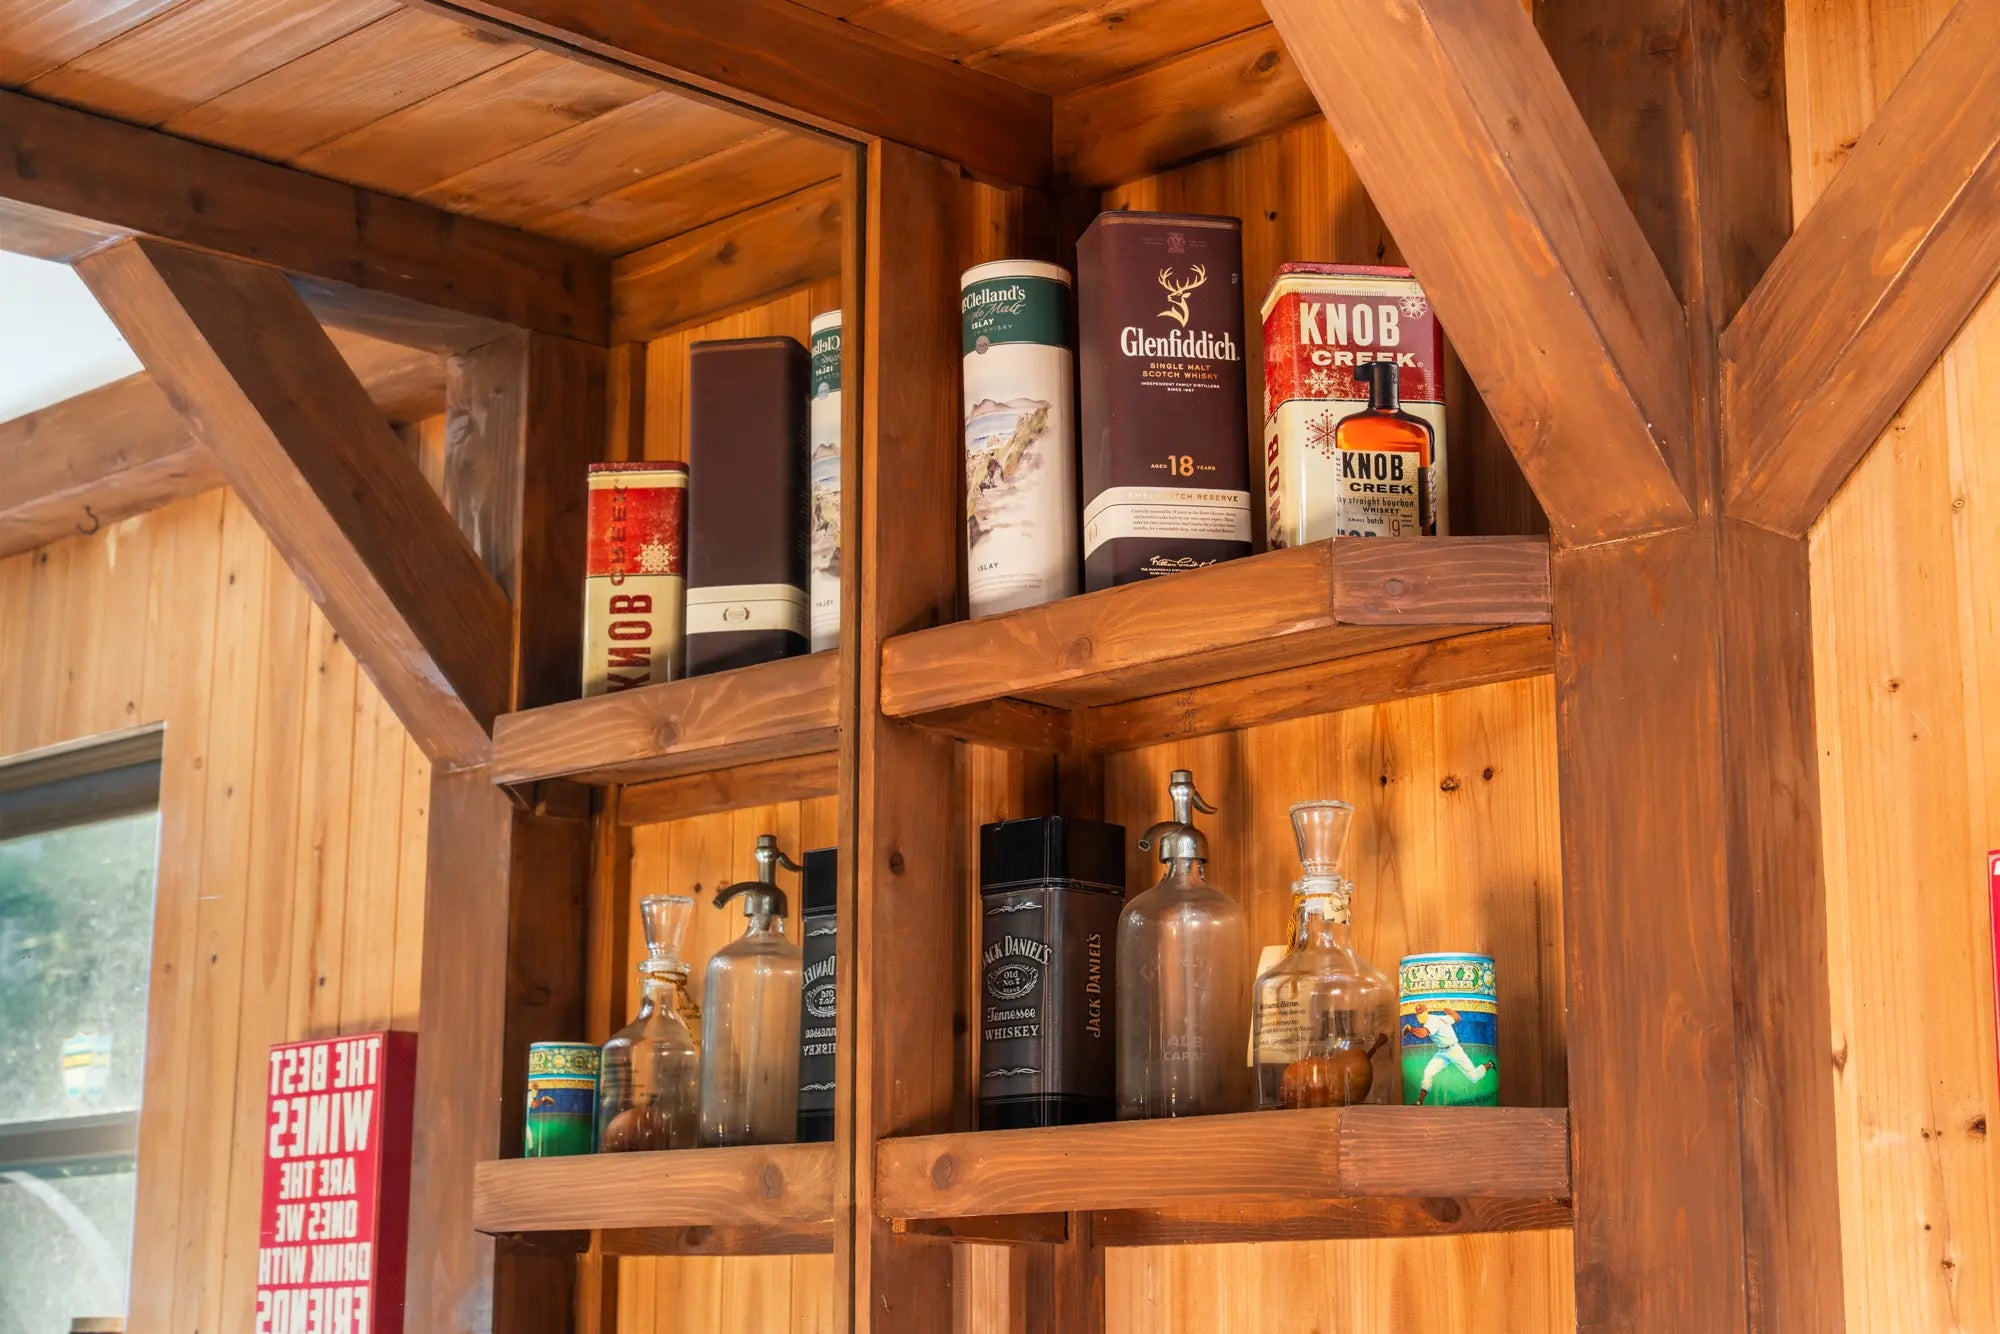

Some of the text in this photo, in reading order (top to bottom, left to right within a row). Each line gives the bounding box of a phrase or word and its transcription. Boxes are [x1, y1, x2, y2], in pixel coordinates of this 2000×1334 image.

[972, 318, 994, 330] ISLAY
[1300, 302, 1400, 347] KNOB
[1120, 326, 1237, 361] Glenfiddich
[1149, 362, 1184, 370] SINGLE
[1142, 370, 1218, 380] SCOTCH WHISKY
[1168, 454, 1194, 477] 18
[1342, 451, 1404, 481] KNOB
[1349, 482, 1414, 494] CREEK
[1197, 493, 1239, 502] RESERVE
[1349, 496, 1380, 507] straight
[1383, 497, 1414, 508] bourbon
[1362, 506, 1401, 514] WHISKEY
[1367, 516, 1384, 525] batch
[977, 561, 999, 572] ISLAY
[1005, 935, 1053, 964] DANIEL'S
[1003, 970, 1018, 979] Old
[1407, 964, 1475, 983] CASEY'S
[1086, 933, 1101, 1038] JACK DANIEL'S
[987, 1006, 1036, 1023] Tennessee
[985, 1024, 1040, 1041] WHISKEY
